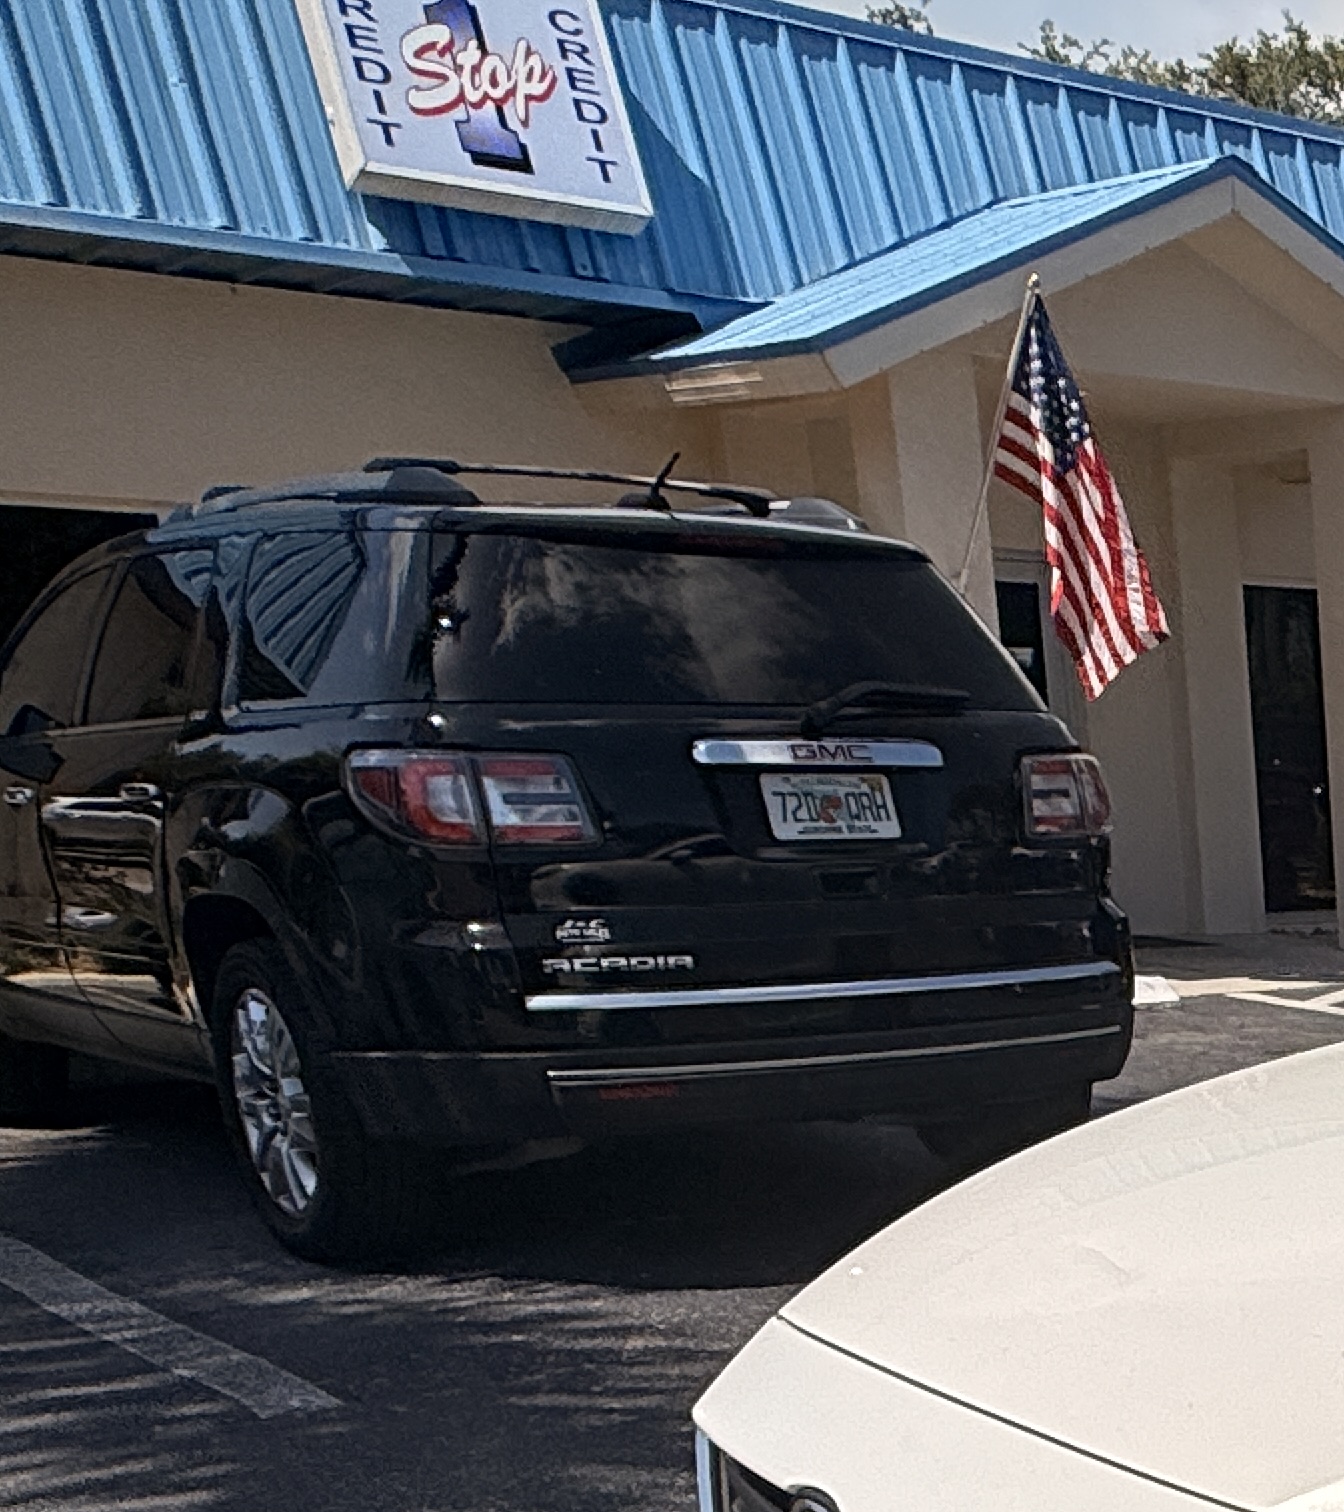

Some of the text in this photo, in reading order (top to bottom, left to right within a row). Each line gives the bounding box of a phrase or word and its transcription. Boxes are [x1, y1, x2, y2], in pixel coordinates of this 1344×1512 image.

[339, 0, 402, 147] REDIT
[401, 22, 557, 129] Stop
[548, 9, 618, 183] CREDIT
[787, 744, 874, 763] GMC
[542, 955, 695, 973] ACADIA
